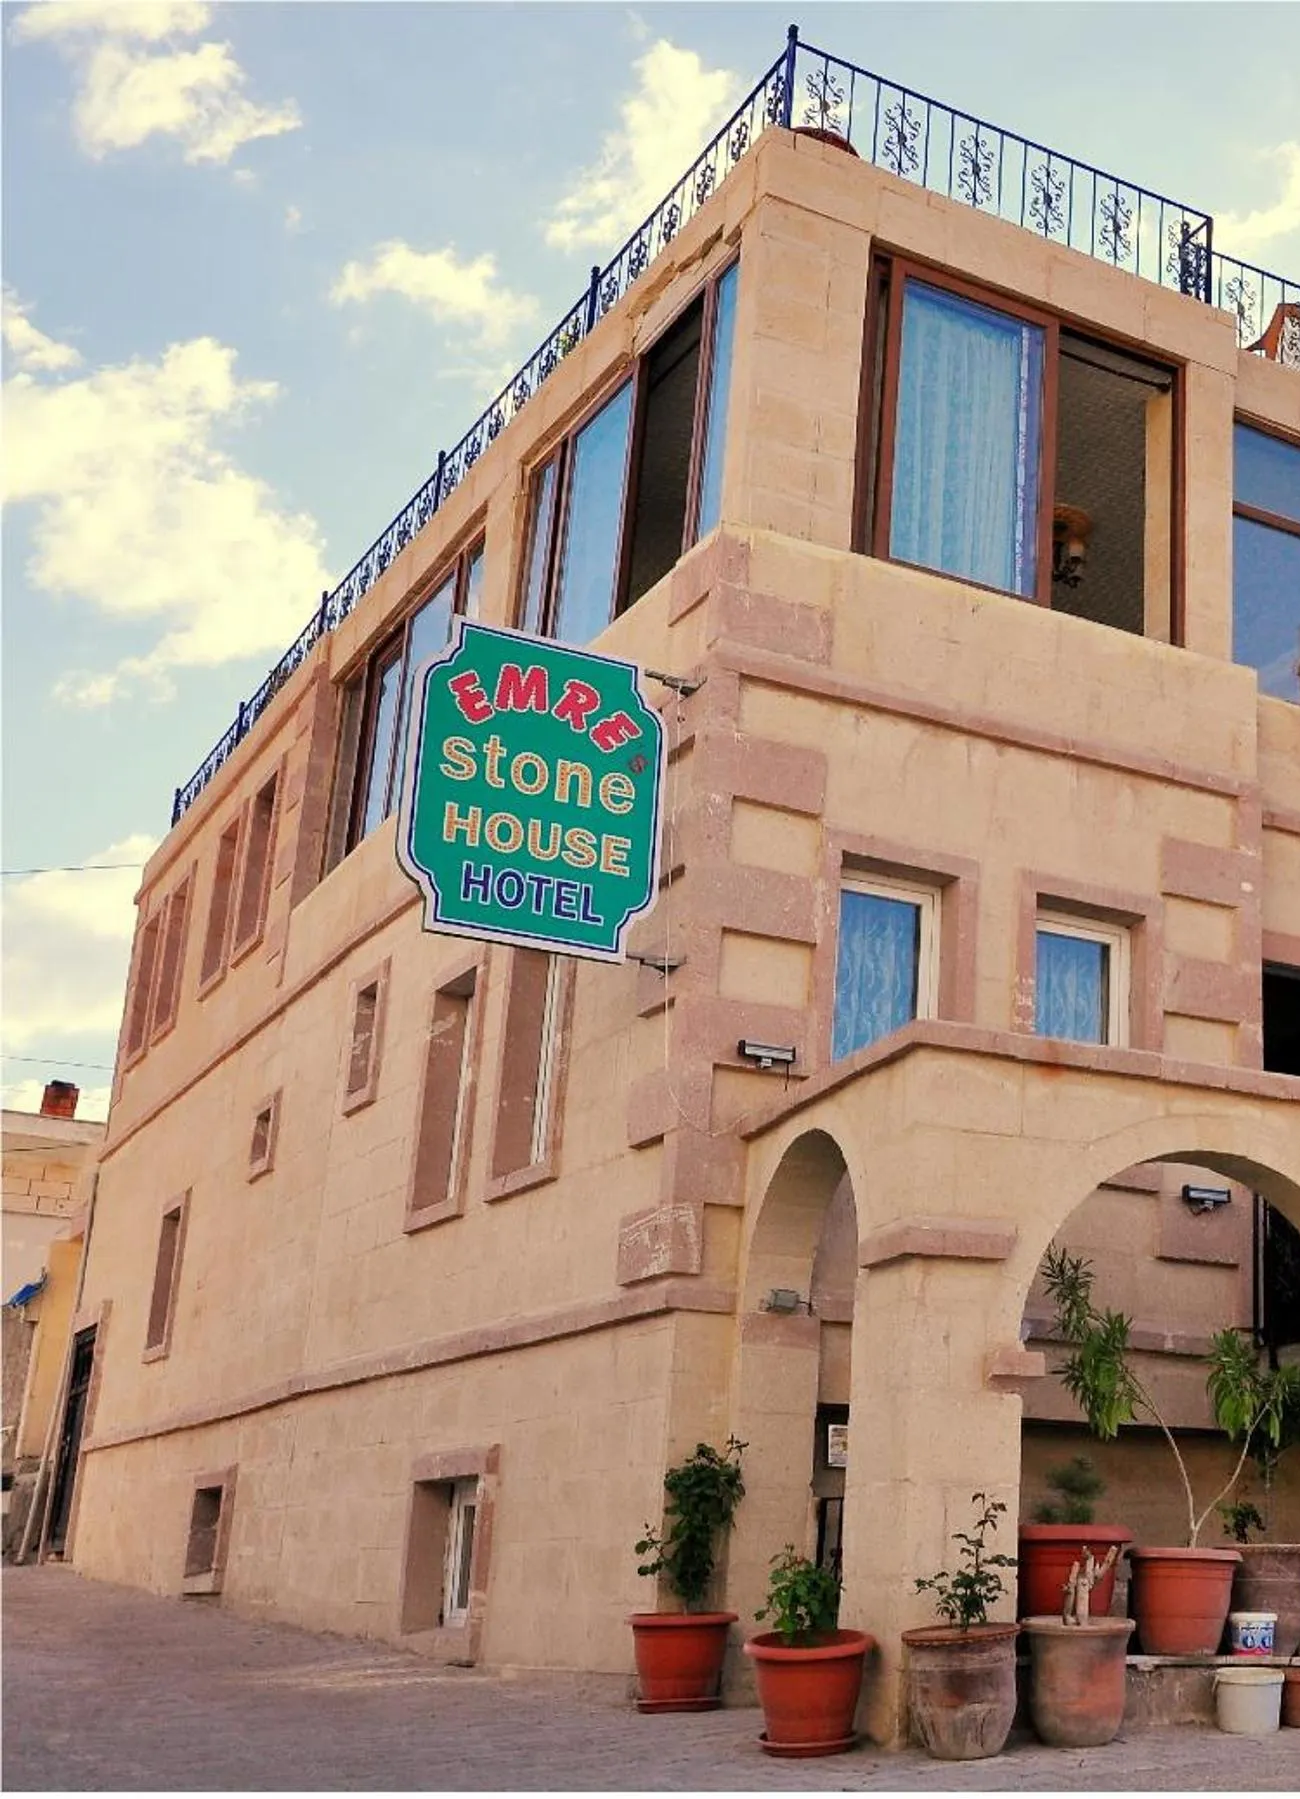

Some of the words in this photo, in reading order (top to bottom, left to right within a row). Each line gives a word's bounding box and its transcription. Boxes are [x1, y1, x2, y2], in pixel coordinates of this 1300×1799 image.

[449, 664, 642, 752] EMRE
[440, 735, 635, 814] stone
[442, 802, 631, 876] HOUSE
[461, 862, 604, 926] HOTEL
